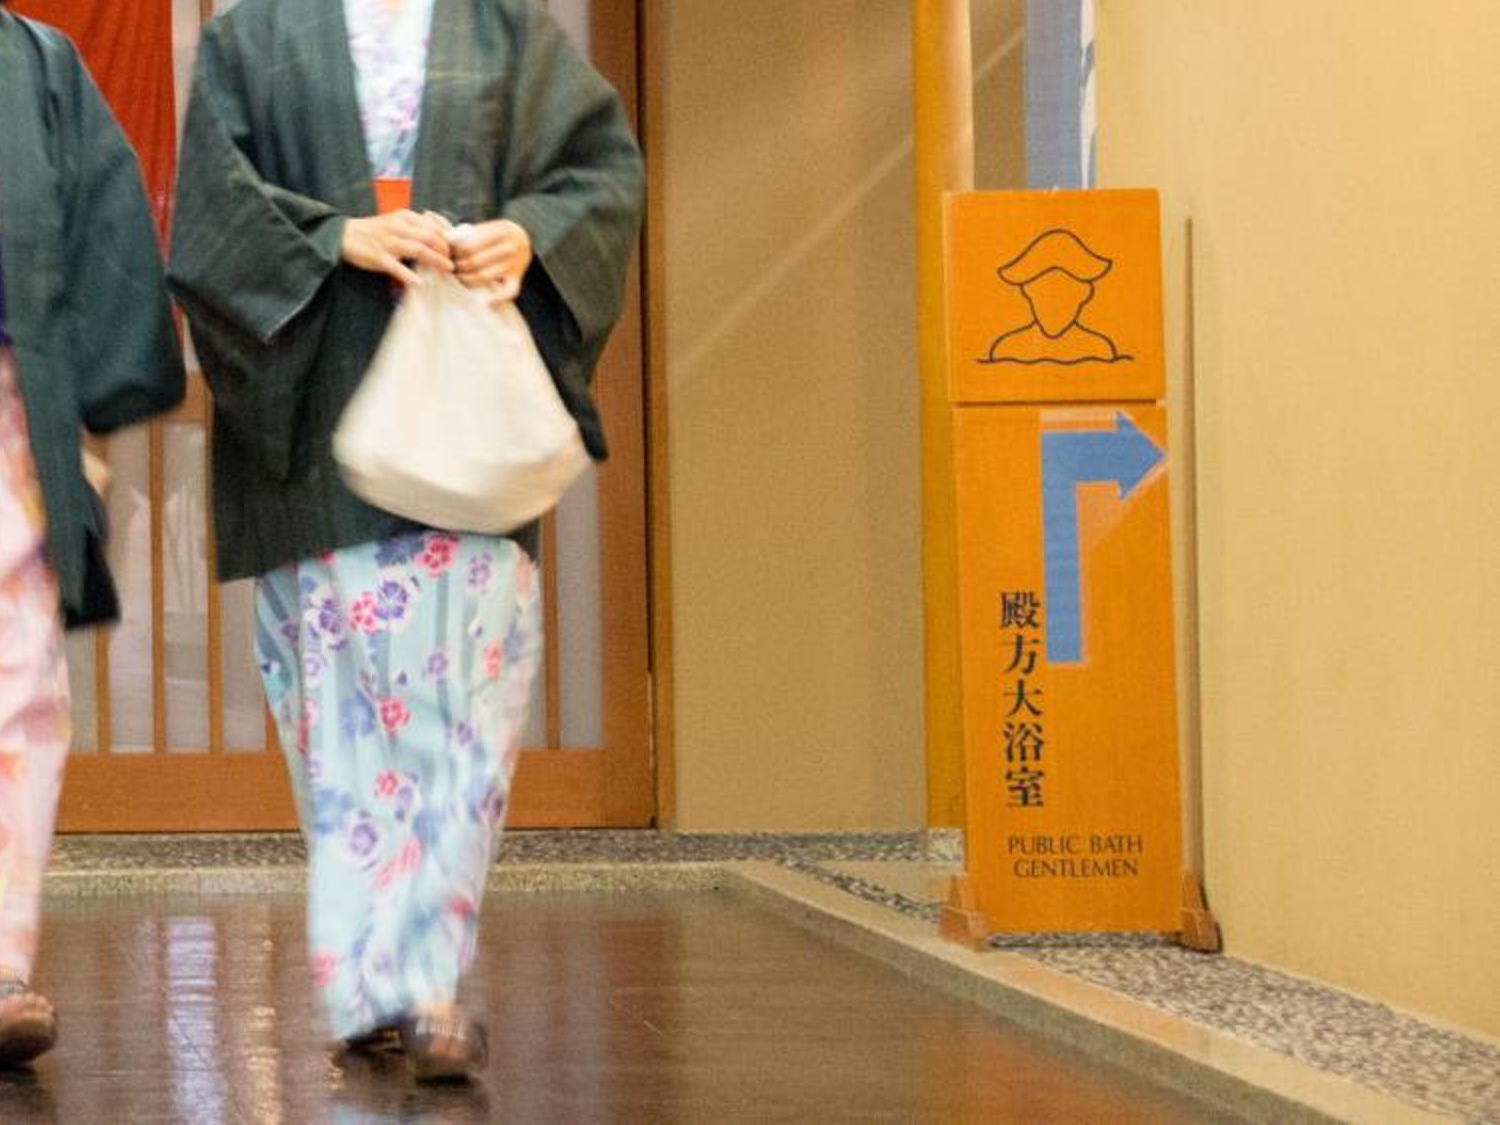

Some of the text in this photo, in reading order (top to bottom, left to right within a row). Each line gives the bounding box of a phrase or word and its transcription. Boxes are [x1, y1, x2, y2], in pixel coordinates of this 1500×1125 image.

[1000, 591, 1044, 808] 殿方大浴室
[1007, 834, 1143, 855] PUBLIC BATH
[1013, 858, 1139, 878] GENTLEMEN
